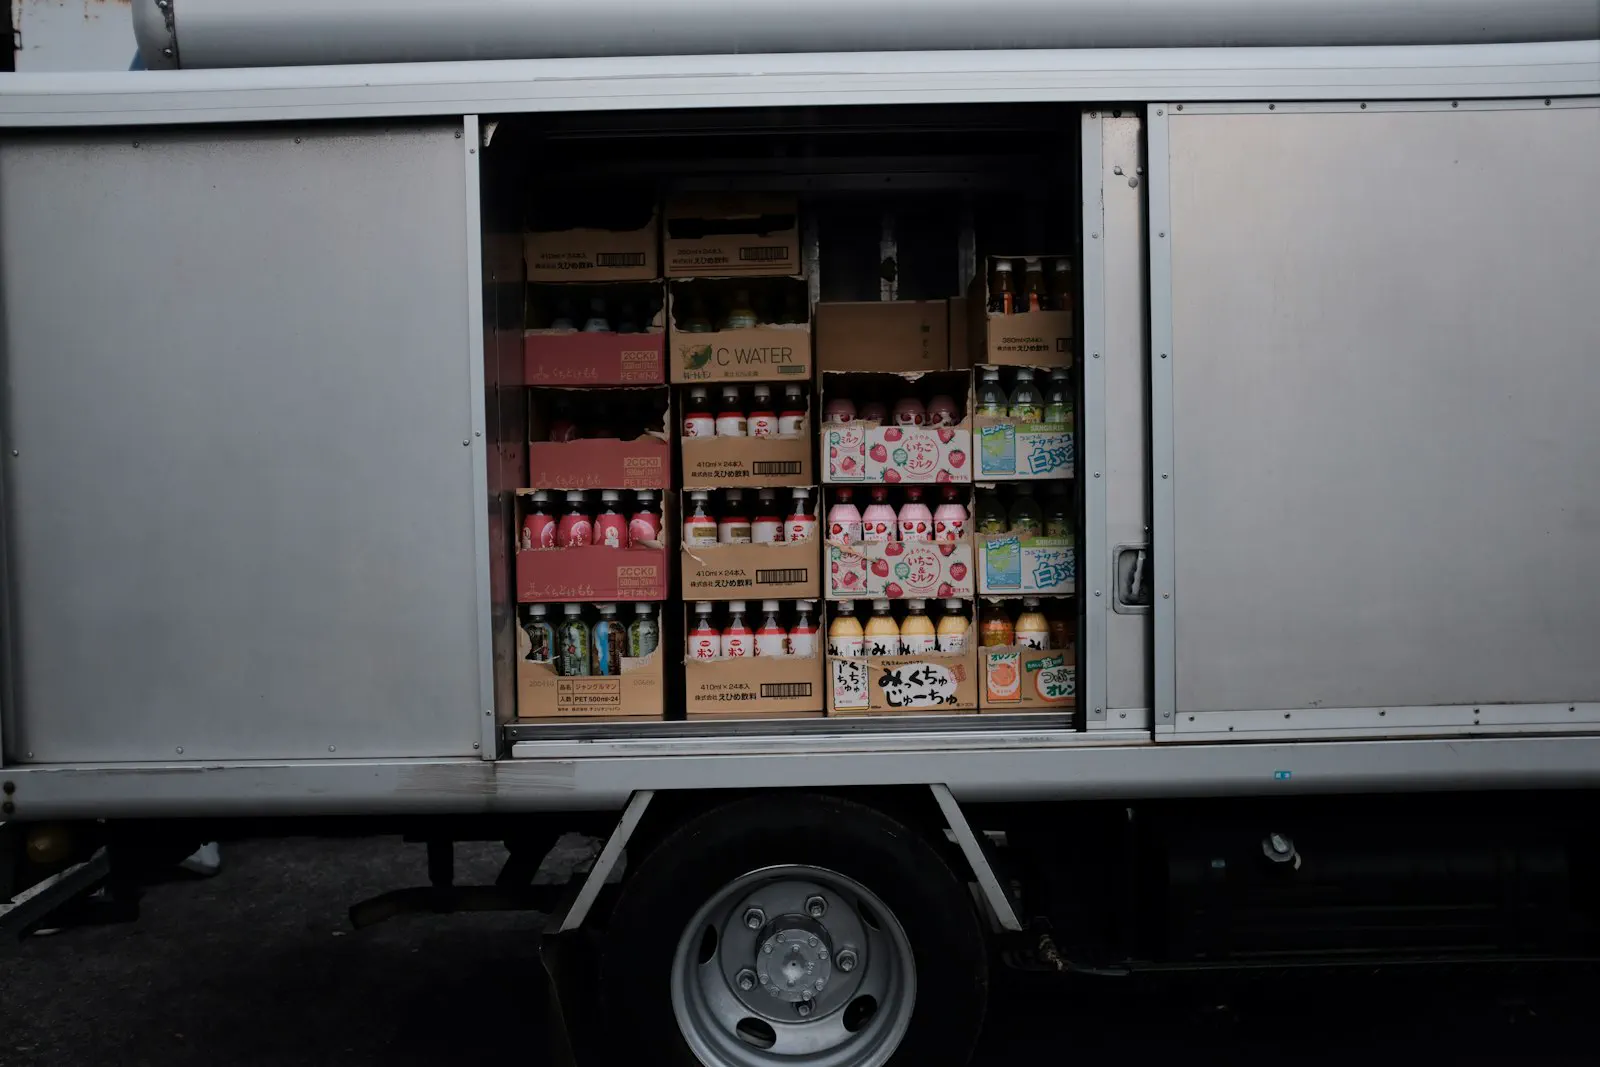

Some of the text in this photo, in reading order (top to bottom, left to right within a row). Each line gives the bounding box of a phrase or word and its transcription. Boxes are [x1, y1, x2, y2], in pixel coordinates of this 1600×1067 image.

[716, 346, 792, 366] C WATER
[906, 442, 933, 453] いちご
[908, 459, 933, 469] ミルク
[908, 555, 935, 566] いちご
[910, 573, 935, 583] ミルク
[878, 666, 948, 688] みっくちゅ
[575, 683, 617, 691] ジャングルマン
[886, 687, 958, 708] じゅーちゅ
